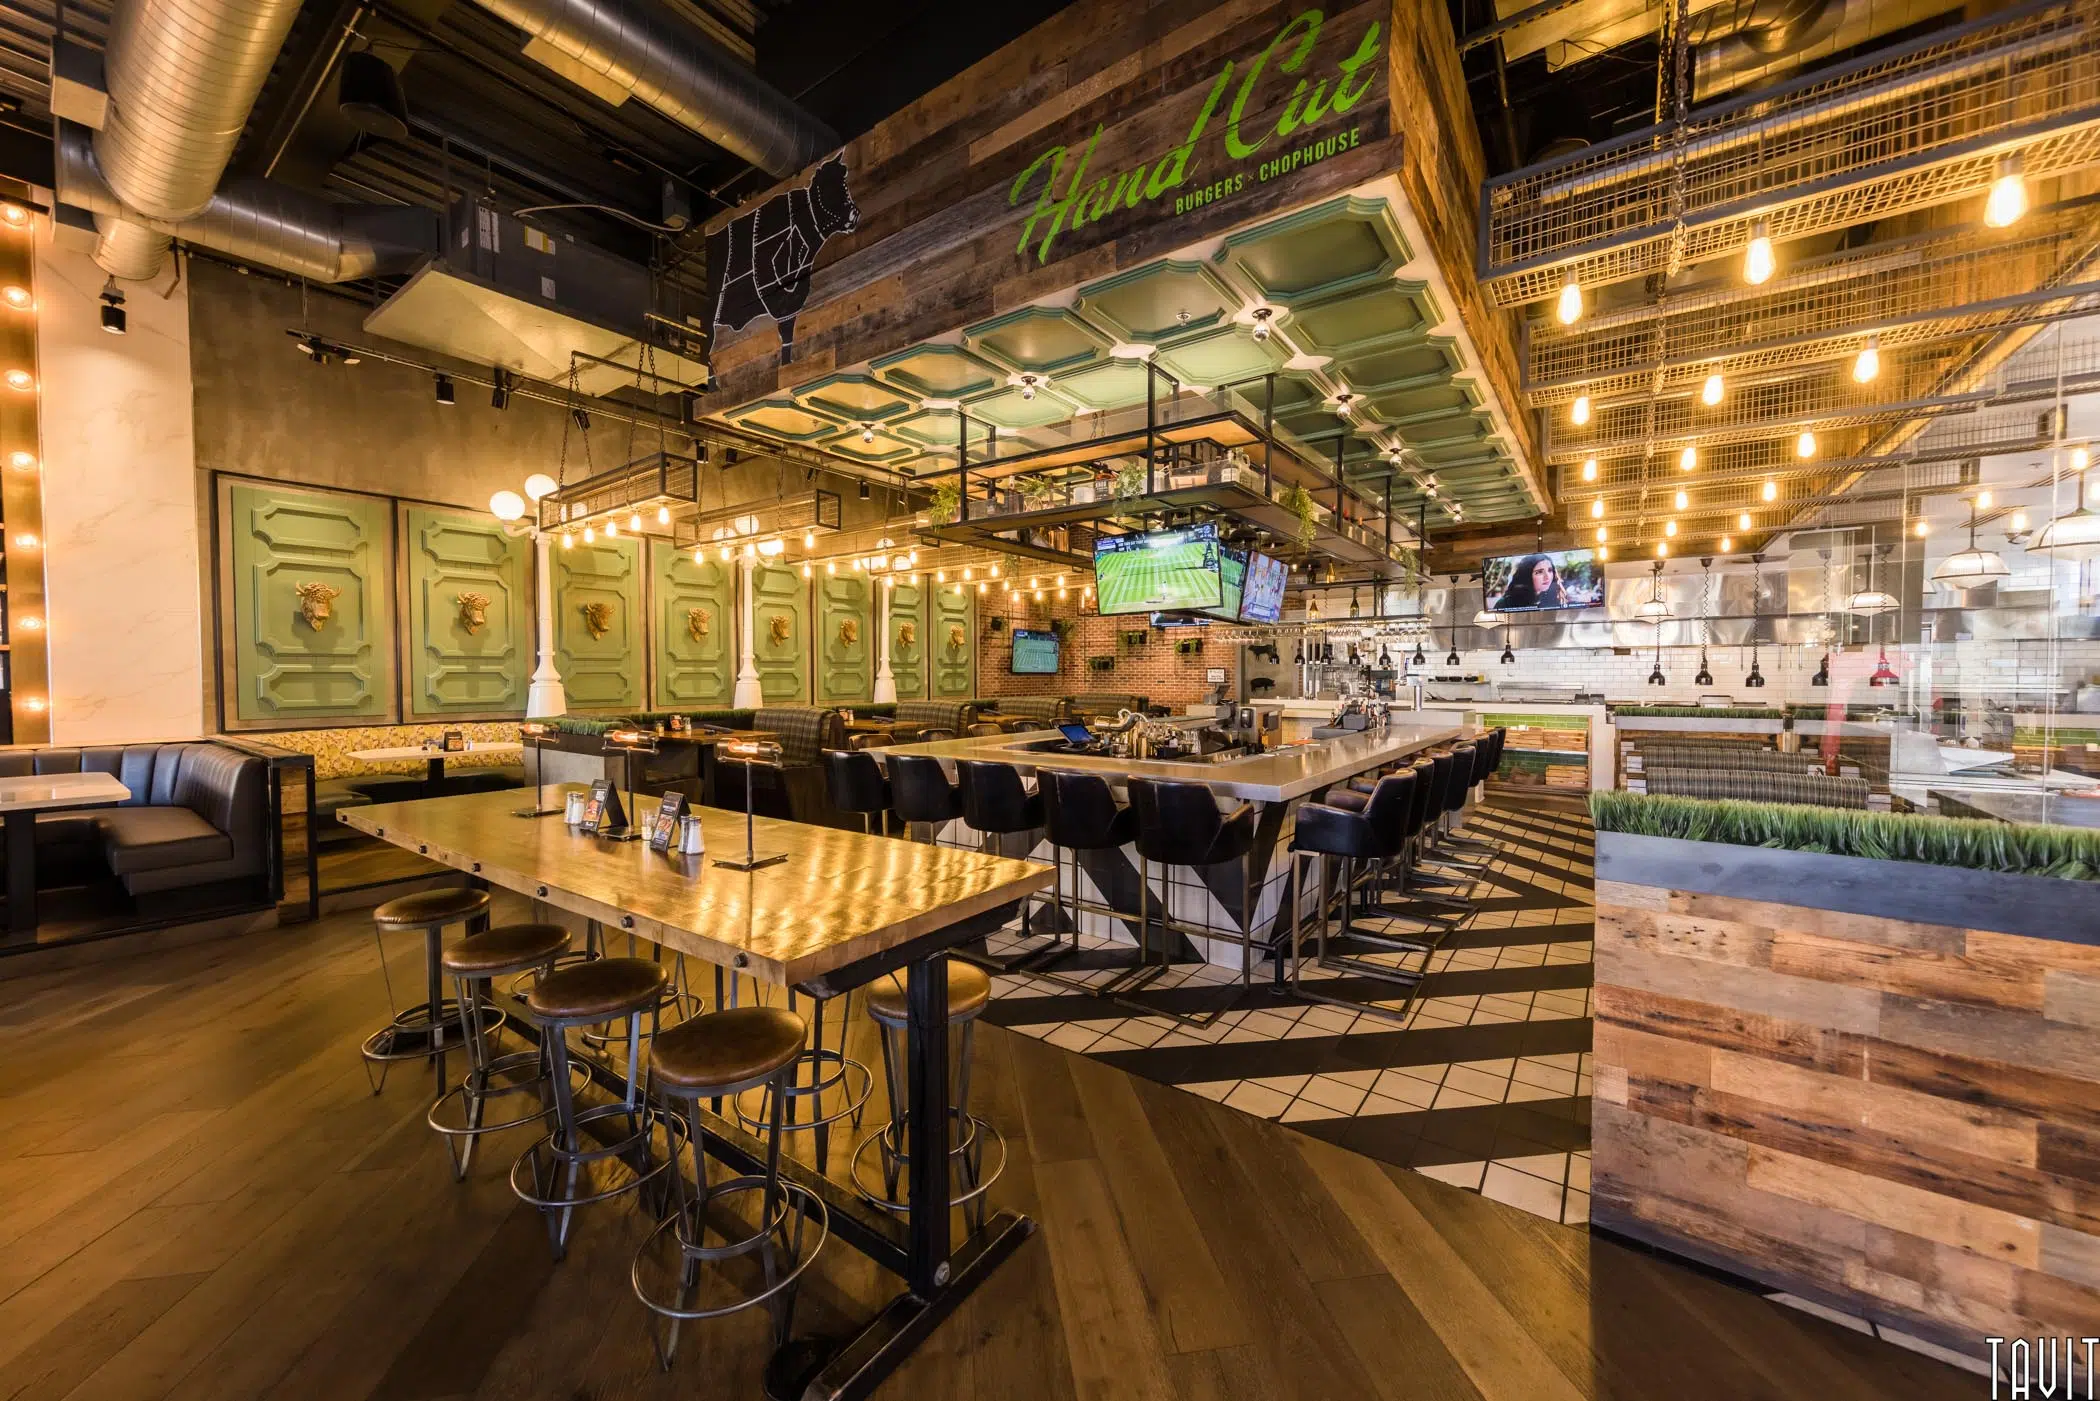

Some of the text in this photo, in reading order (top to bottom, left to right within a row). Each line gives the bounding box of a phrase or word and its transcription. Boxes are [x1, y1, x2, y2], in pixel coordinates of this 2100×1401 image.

[1008, 8, 1382, 265] Hand Cut
[1174, 127, 1361, 216] BURGERS CHOPHOUSE
